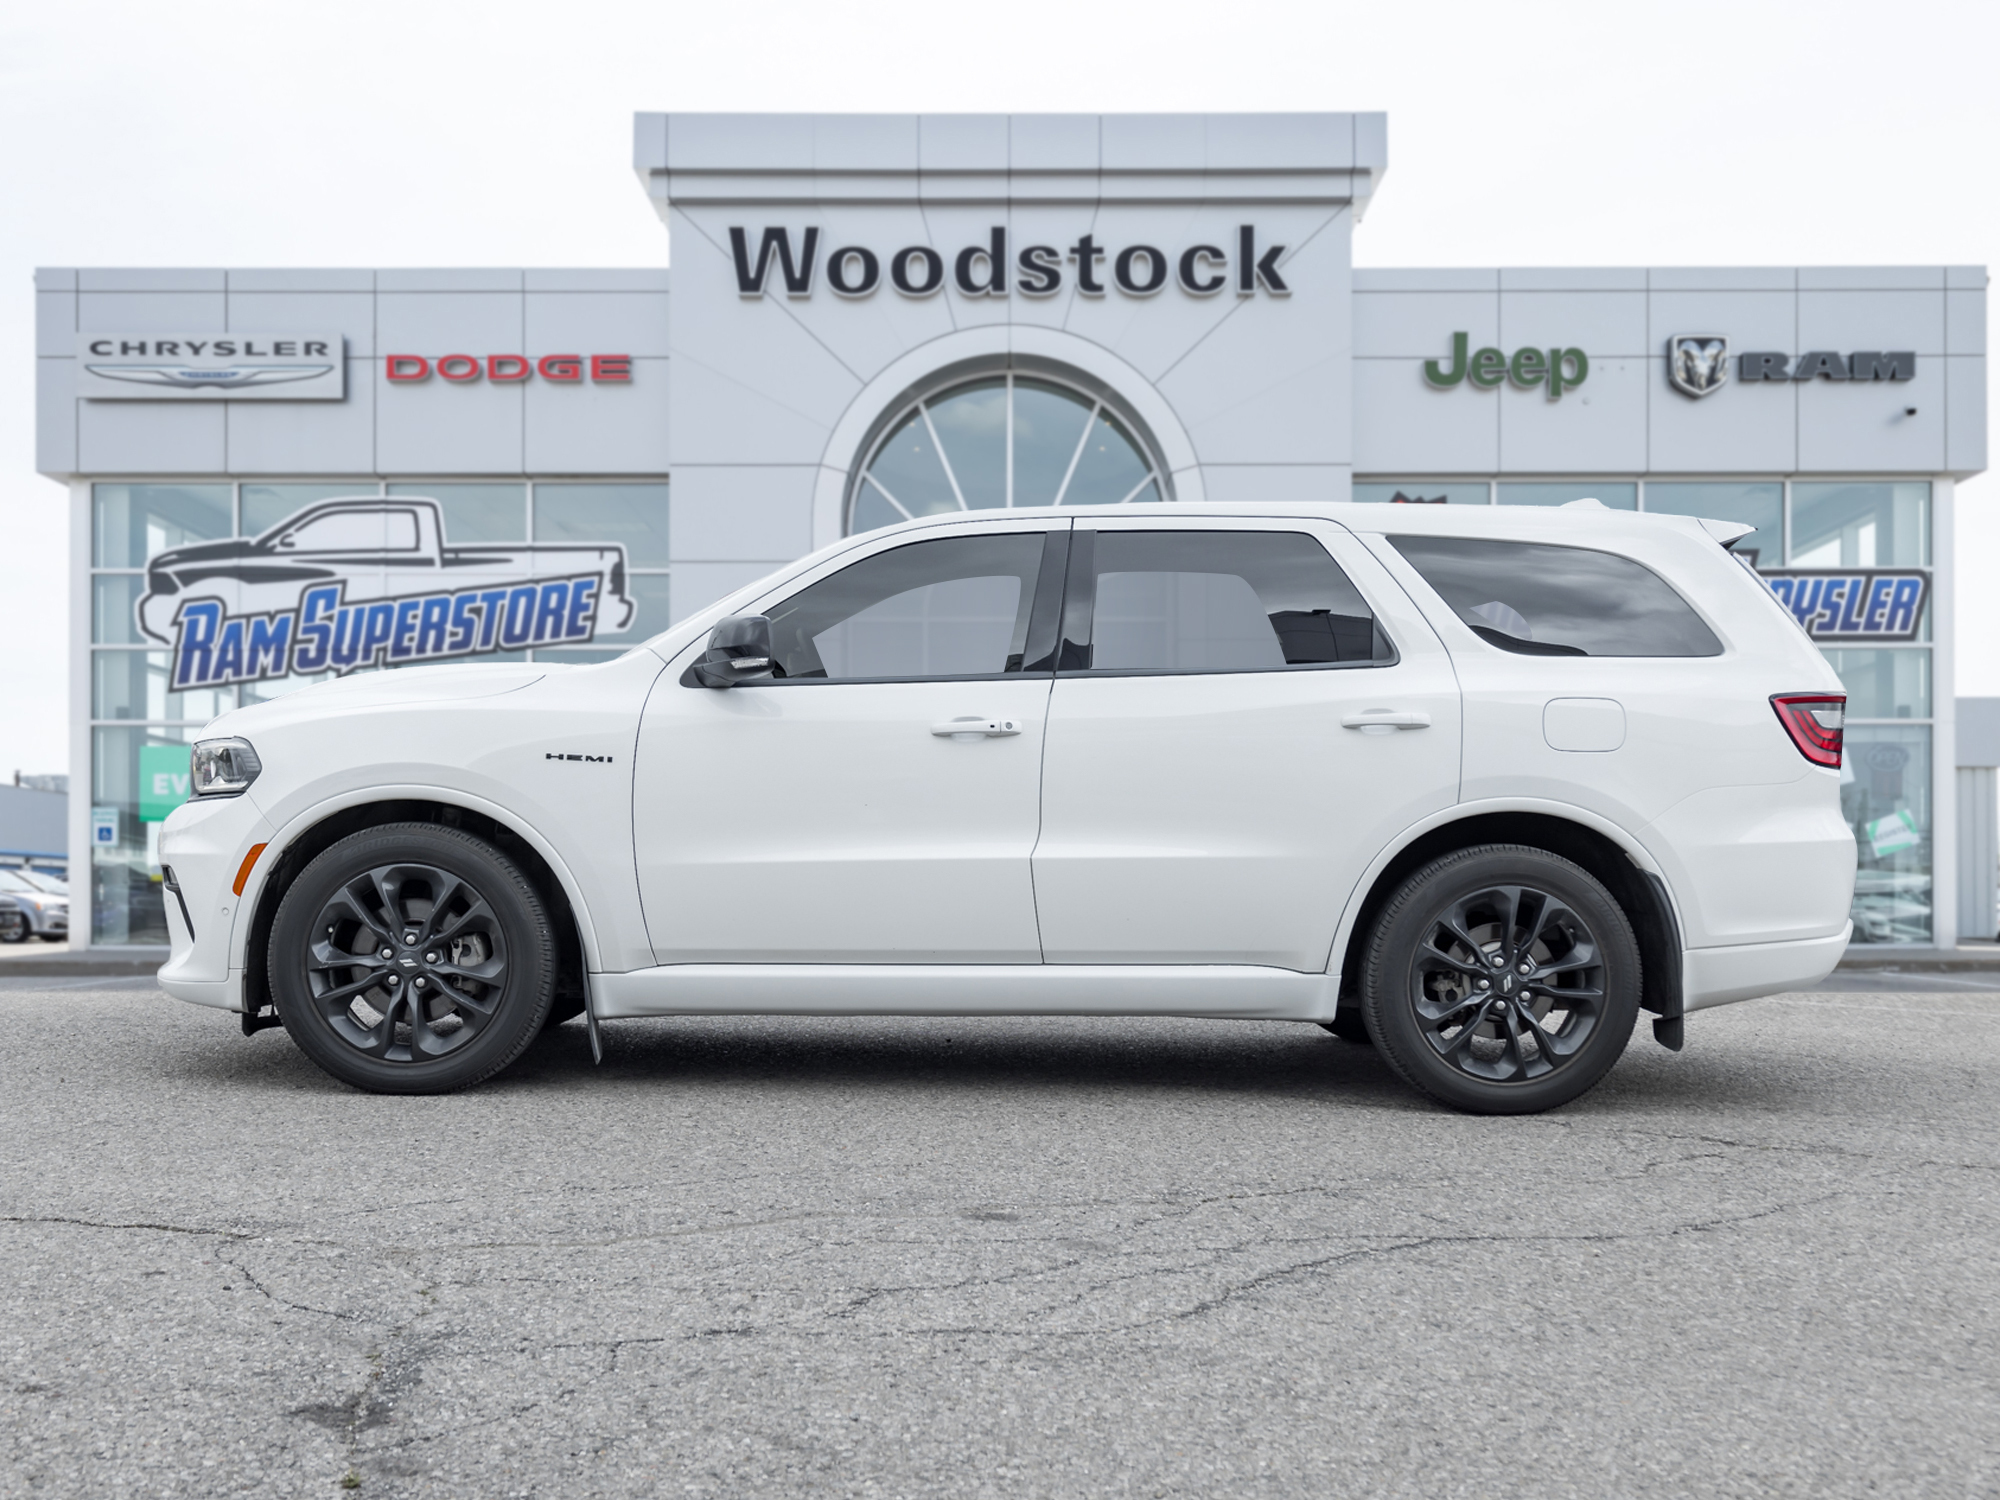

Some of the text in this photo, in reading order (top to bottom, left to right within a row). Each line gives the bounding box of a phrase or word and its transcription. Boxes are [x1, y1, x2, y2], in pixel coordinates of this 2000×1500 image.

[728, 225, 1291, 297] Woodstock
[89, 340, 329, 357] CHRYSLER
[386, 354, 630, 381] DODGE
[1424, 331, 1589, 397] Jeep
[1738, 352, 1916, 382] RAM
[1763, 578, 1922, 632] YSLER
[177, 578, 599, 685] RAM SUPERSTORE
[545, 753, 613, 763] HEMI
